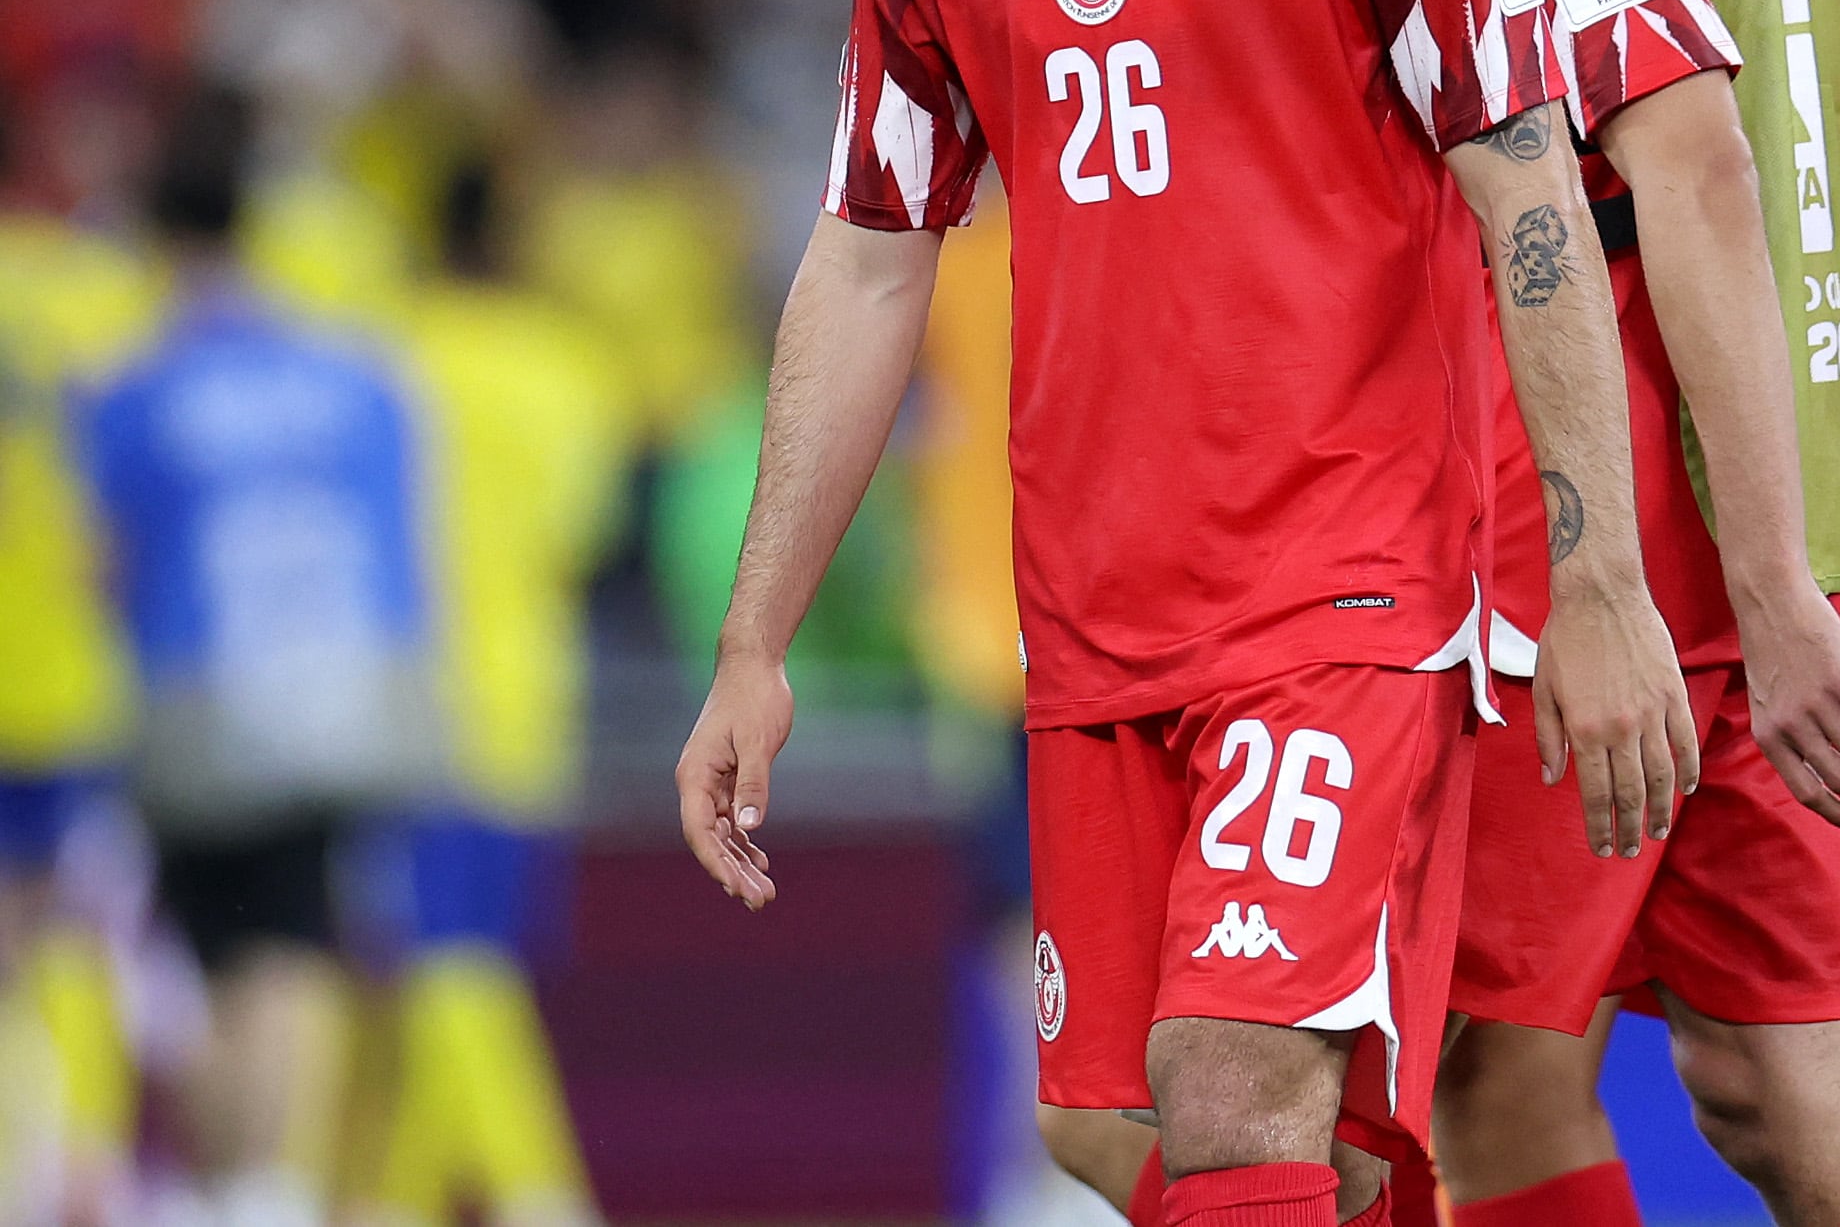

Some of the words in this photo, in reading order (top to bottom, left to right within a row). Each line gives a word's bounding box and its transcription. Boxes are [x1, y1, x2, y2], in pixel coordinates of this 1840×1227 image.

[1044, 39, 1170, 204] 26
[1335, 597, 1392, 608] KOMBAT
[1200, 718, 1353, 888] 26
